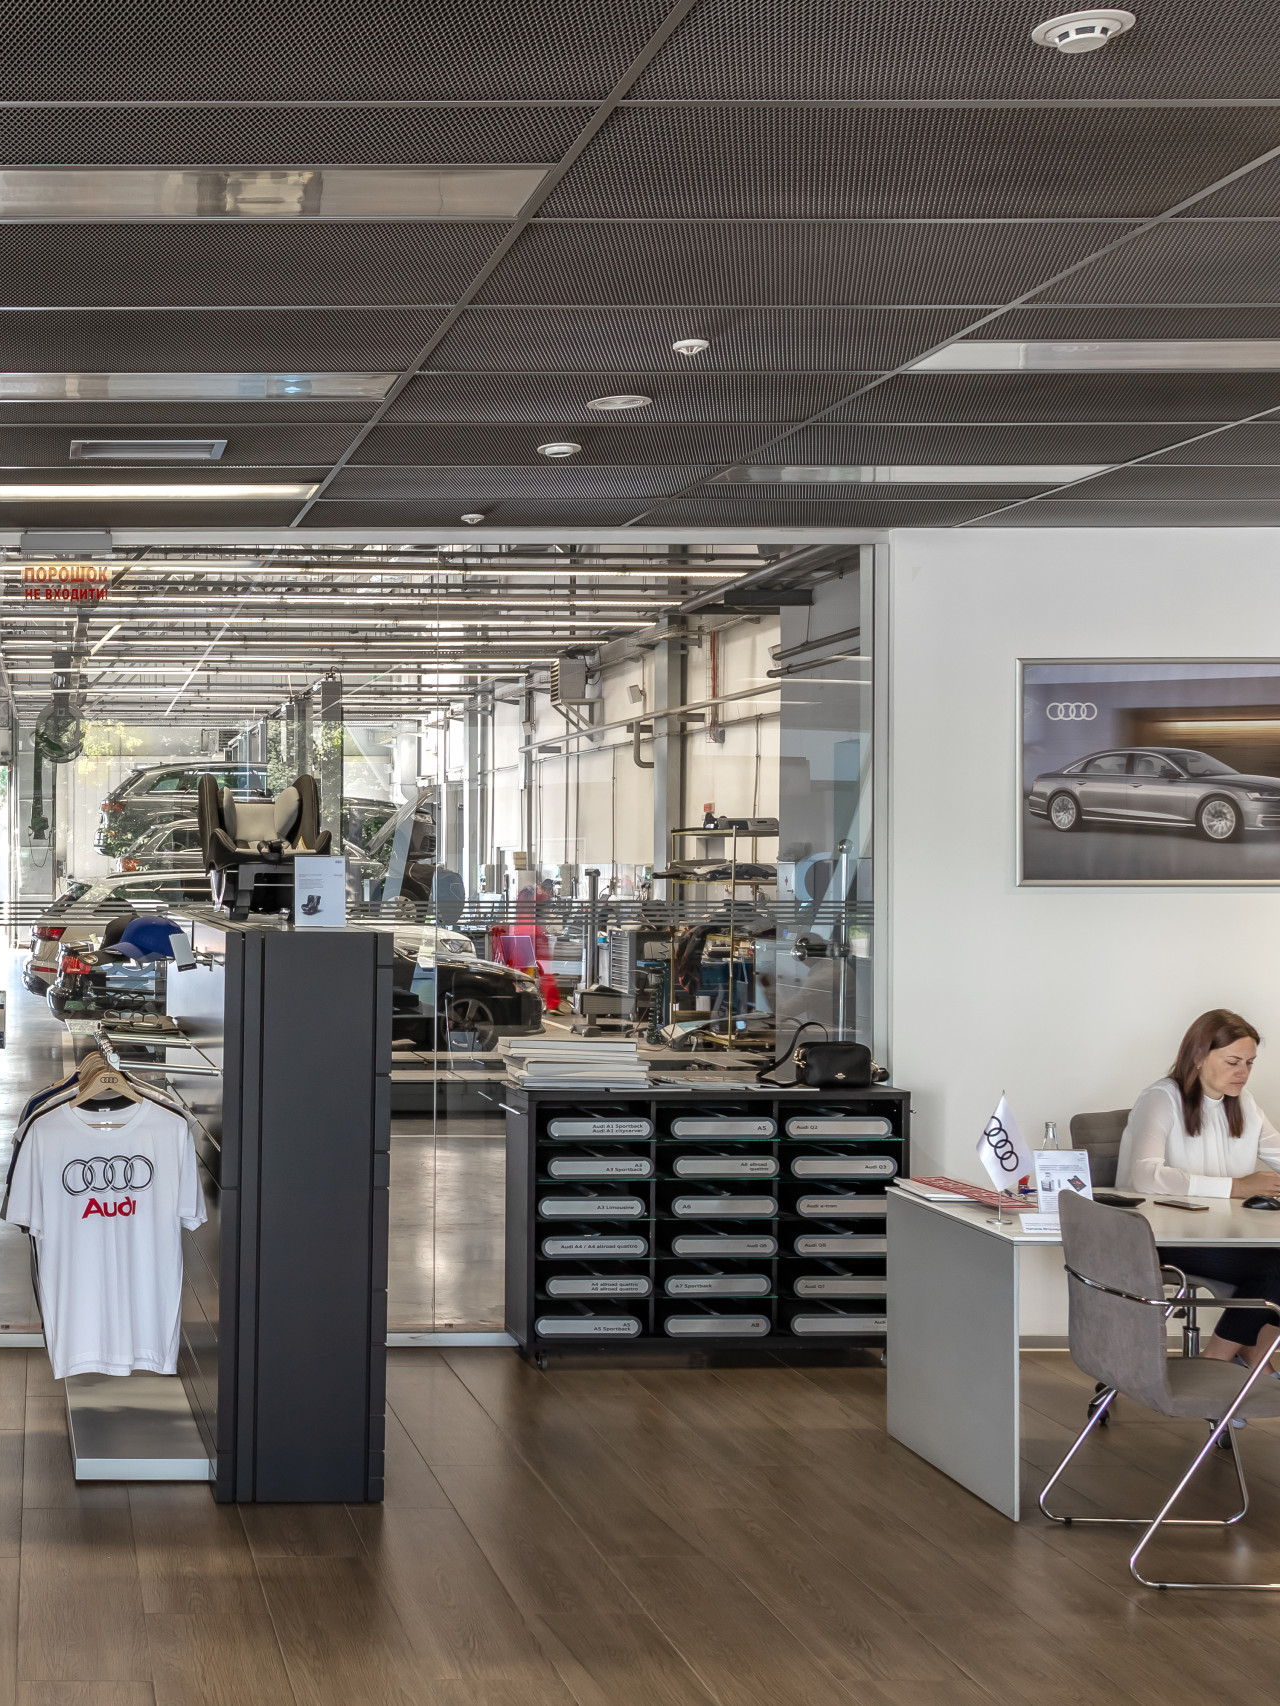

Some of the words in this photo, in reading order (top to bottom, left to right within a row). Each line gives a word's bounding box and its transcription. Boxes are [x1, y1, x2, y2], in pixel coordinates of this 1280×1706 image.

[24, 566, 108, 583] ПОРОШОК
[25, 588, 41, 600] НЕ
[45, 588, 108, 602] ВХОДИТИ!
[81, 1196, 137, 1220] Audi
